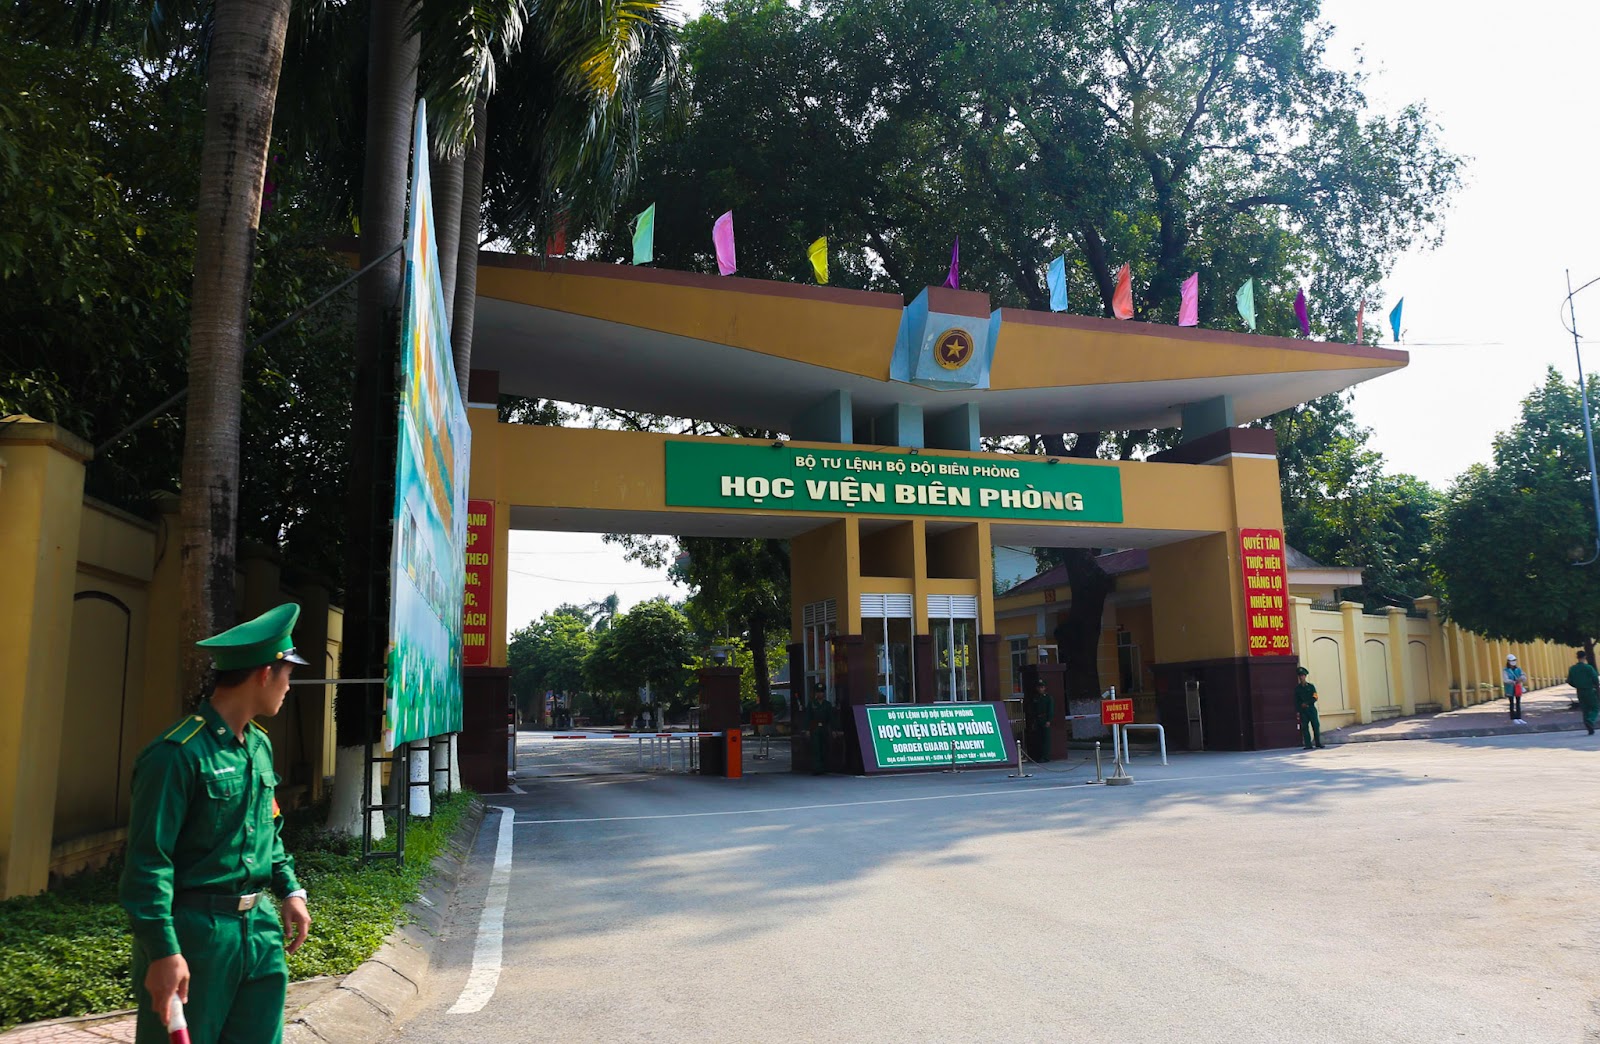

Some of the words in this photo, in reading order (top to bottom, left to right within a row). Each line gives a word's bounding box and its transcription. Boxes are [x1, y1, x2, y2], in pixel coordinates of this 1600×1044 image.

[795, 454, 816, 471] BỘ
[821, 457, 842, 469] TƯ
[845, 456, 882, 473] LỆNH
[886, 458, 906, 475] BỘ
[910, 460, 936, 476] ĐỘI
[939, 462, 969, 476] BIÊN
[972, 464, 1020, 479] PHÒNG
[721, 475, 795, 503] HỌC
[805, 476, 886, 507] VIỆN
[895, 480, 971, 506] BIÊN
[979, 483, 1084, 511] PHÒNG
[467, 513, 487, 528] ẠNH
[466, 530, 478, 548] ẬP
[1243, 533, 1264, 550] QUYẾT
[1265, 534, 1280, 550] TÂM
[1246, 555, 1264, 572] THỰC
[1264, 554, 1281, 572] HIỆN
[464, 572, 481, 586] NG,
[1247, 571, 1270, 589] THẮNG
[1270, 575, 1282, 592] LỢI
[463, 590, 478, 607] ỨC,
[1250, 593, 1273, 611] NHIỆM
[1273, 595, 1283, 611] VỤ
[1252, 613, 1269, 629] NĂM
[1269, 615, 1284, 631] HỌC
[1250, 635, 1268, 649] 2022
[1272, 635, 1290, 648] 2023
[888, 711, 896, 720] BỘ
[896, 711, 904, 719] TƯ
[905, 710, 920, 720] LỆNH
[920, 710, 929, 720] BỘ
[929, 710, 940, 719] ĐỘI
[940, 709, 954, 718] BIÊN
[954, 708, 974, 717] PHÒNG
[1110, 712, 1125, 720] STOP
[878, 724, 902, 741] HỌC
[902, 721, 930, 740] VIỆN
[930, 720, 957, 737] BIÊN
[957, 719, 994, 736] PHÒNG
[892, 742, 924, 753] BORDER
[924, 741, 950, 752] GUARD
